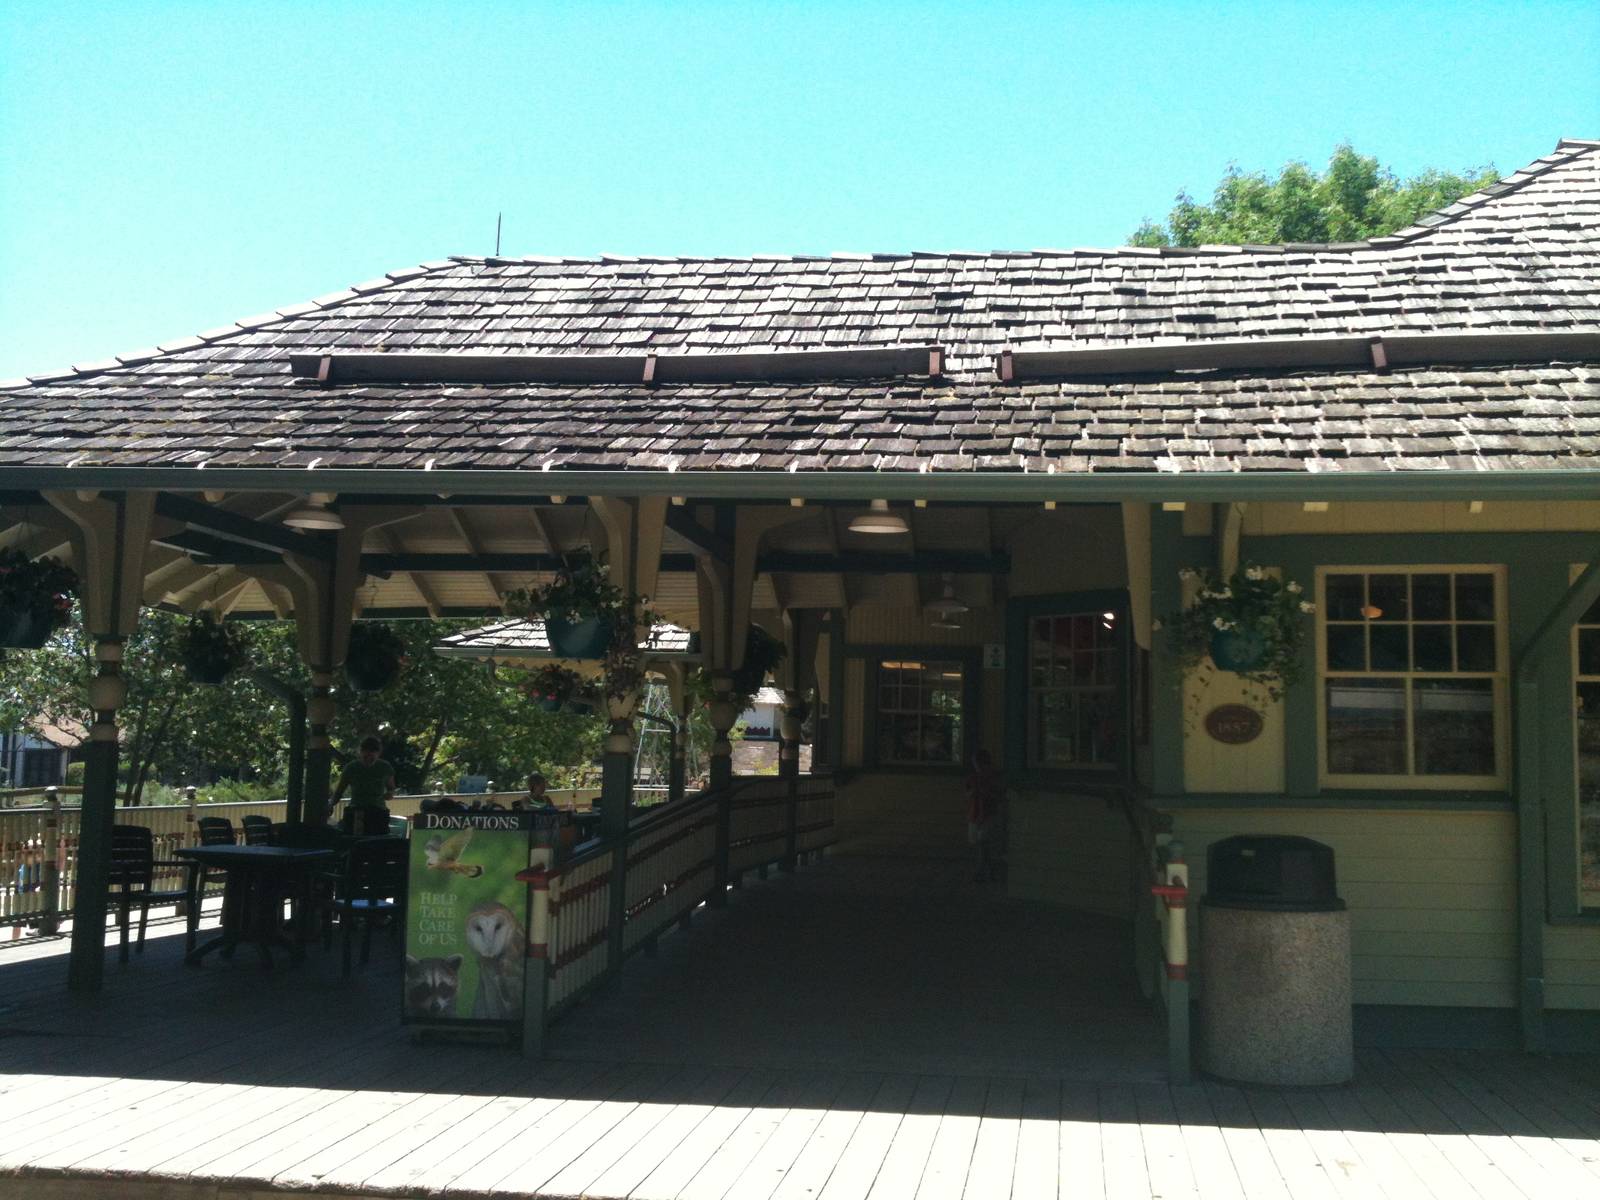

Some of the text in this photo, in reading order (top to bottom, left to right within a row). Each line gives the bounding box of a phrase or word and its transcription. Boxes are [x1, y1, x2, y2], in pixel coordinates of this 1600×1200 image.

[426, 814, 519, 829] DONATIONS
[420, 892, 458, 905] HELP
[420, 905, 456, 918] TAKE
[419, 919, 455, 932] CARE
[418, 933, 457, 945] OF US
